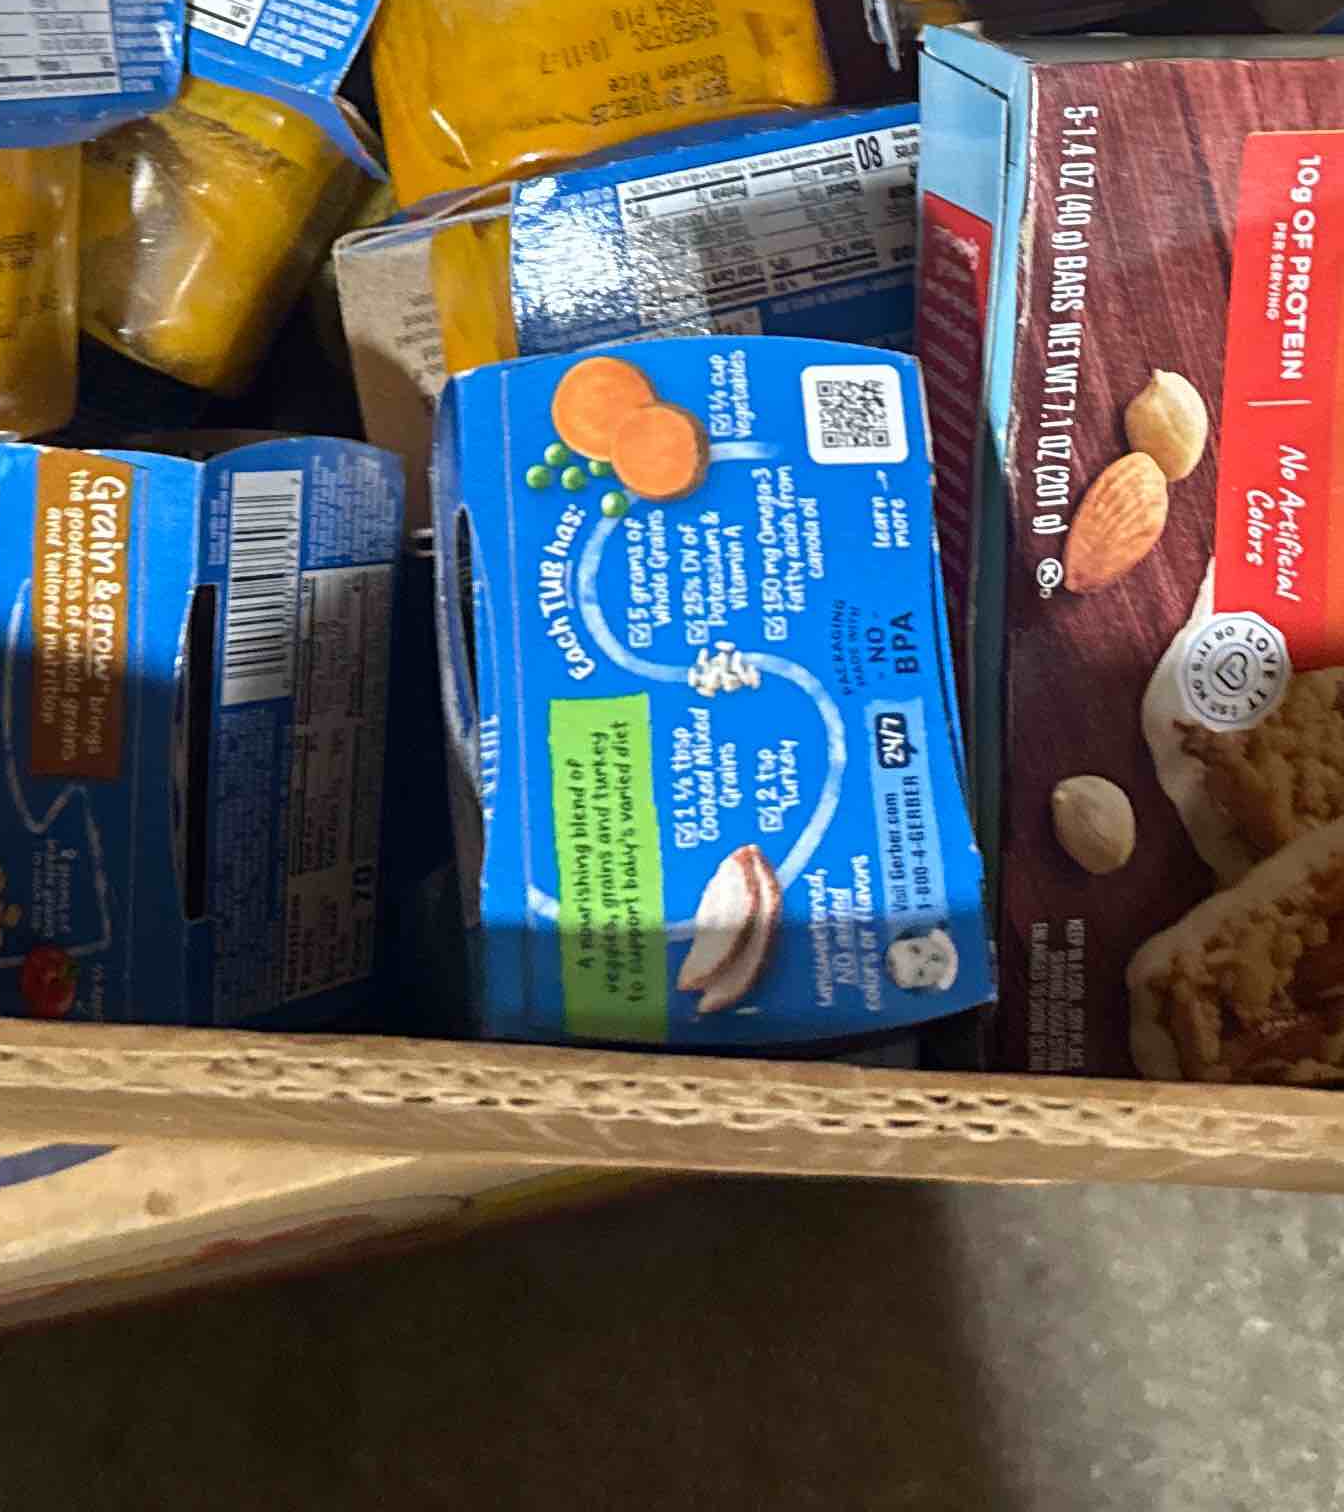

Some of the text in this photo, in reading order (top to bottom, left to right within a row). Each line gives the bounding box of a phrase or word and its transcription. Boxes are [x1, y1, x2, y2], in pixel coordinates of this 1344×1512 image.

[853, 134, 884, 171] 80
[1263, 221, 1287, 322] PER SERVING
[1276, 154, 1323, 381] 10g OF PROTEIN
[1030, 103, 1098, 537] 5-1.4 OZ (40 g) BARS NET WT 7.1 OZ (201 g)
[86, 474, 126, 574] Grain
[624, 515, 652, 619] 5 grams of
[644, 509, 672, 626] Whole Grains
[678, 523, 704, 616] 25% DV of
[723, 524, 747, 609] Vitamin A
[751, 466, 786, 613] 150 mg Omega-3
[773, 464, 809, 613] fatty acids from
[799, 496, 825, 579] canola oil
[890, 496, 911, 548] more
[1239, 488, 1275, 567] Colors
[1269, 444, 1307, 602] No Artificial
[38, 506, 64, 725] and tailored nutrition
[59, 469, 88, 761] the goodness of whole grains
[90, 577, 121, 602] &
[536, 502, 596, 680] Each TUB has:
[888, 610, 920, 674] BPA
[1242, 627, 1279, 679] LOVE
[85, 696, 106, 756] brings
[686, 706, 722, 841] Cooked Mixed
[716, 740, 743, 809] Grains
[773, 737, 802, 808] Turkey
[879, 715, 906, 766] 24/7
[588, 730, 624, 994] veggies, grains and turkey
[609, 719, 650, 1003] to support baby's varied diet
